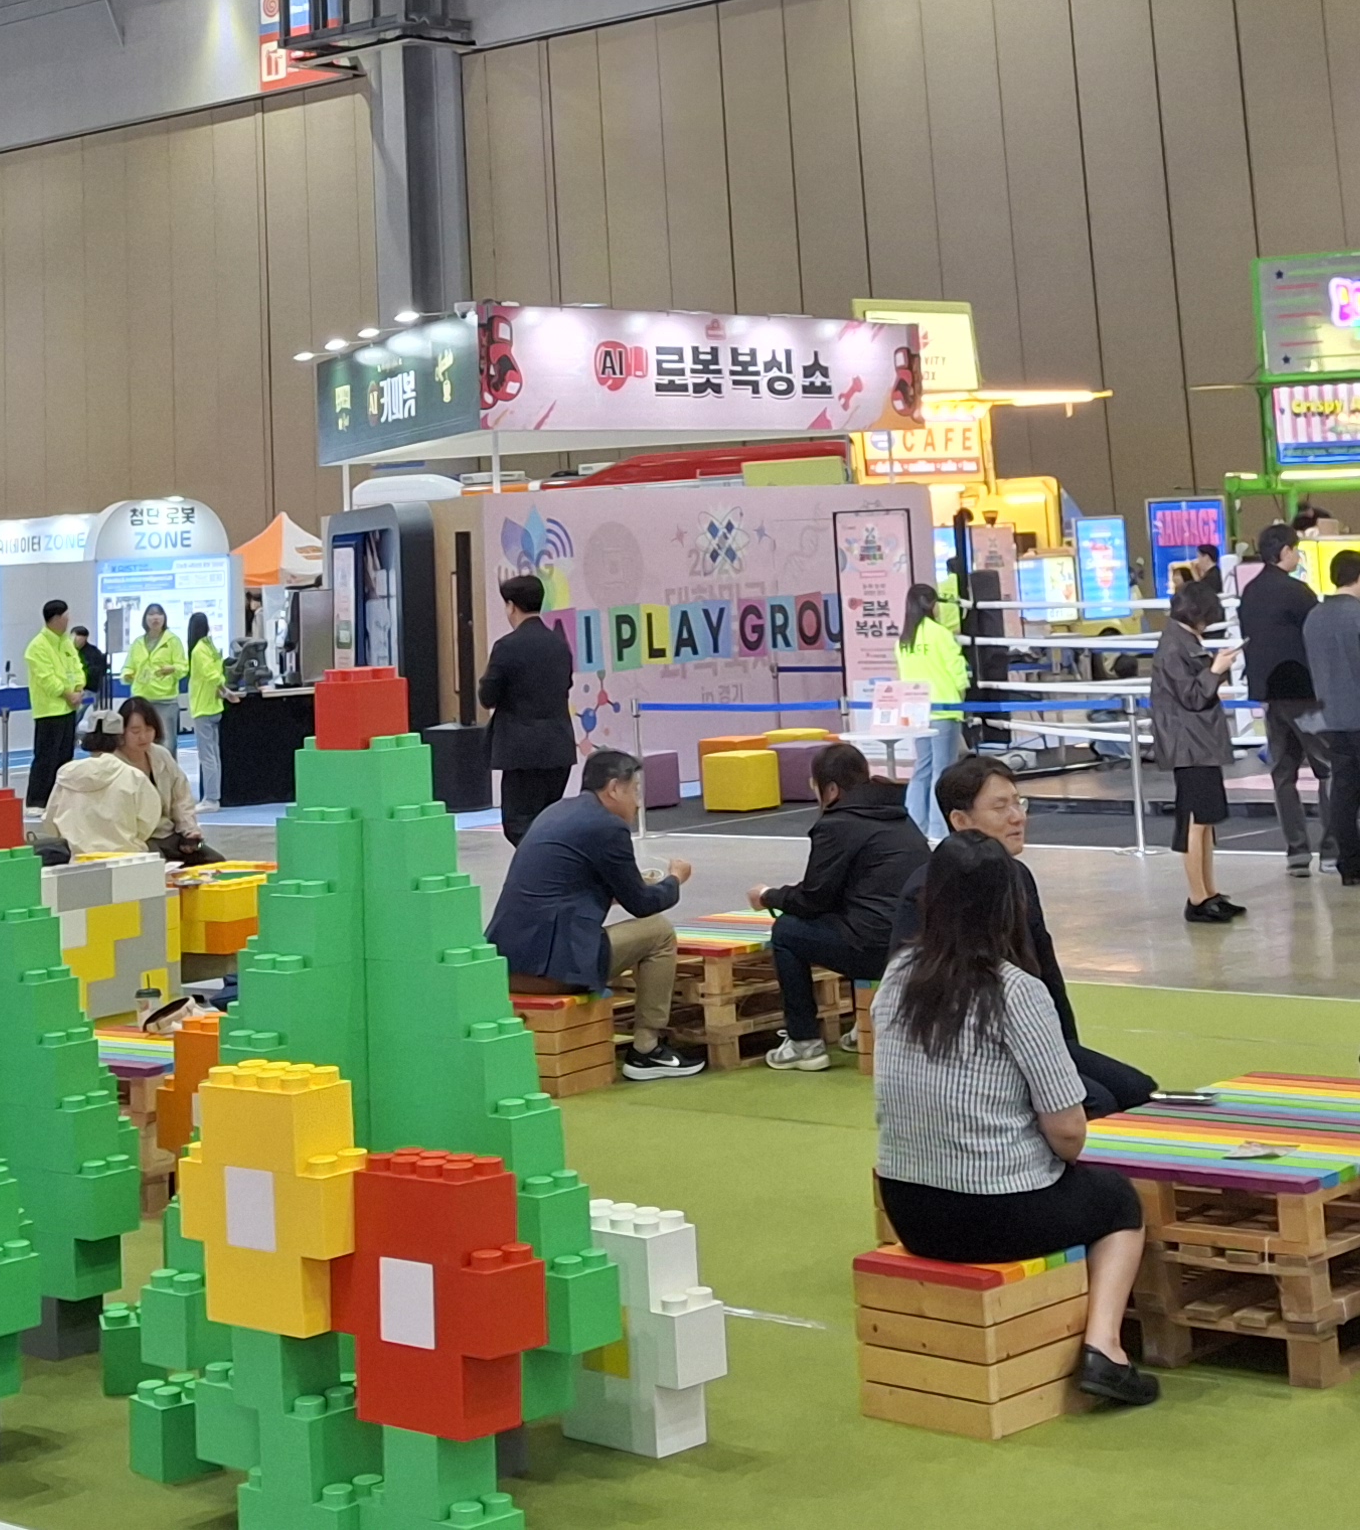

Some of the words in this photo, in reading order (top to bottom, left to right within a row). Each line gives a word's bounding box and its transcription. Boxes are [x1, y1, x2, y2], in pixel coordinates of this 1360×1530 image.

[601, 350, 624, 377] AI
[654, 345, 725, 396] 로봇
[729, 347, 797, 399] 복싱
[801, 350, 834, 398] 쇼
[380, 370, 416, 423] 커피봇
[902, 427, 974, 453] CAFE
[130, 507, 160, 526] 첨단
[166, 506, 196, 525] 로봇
[1155, 509, 1220, 547] SAUSAGE
[44, 532, 86, 552] ZONE
[134, 530, 193, 550] ZONE
[862, 600, 890, 618] 로봇
[616, 606, 726, 662] PLAY
[856, 620, 883, 638] 복싱
